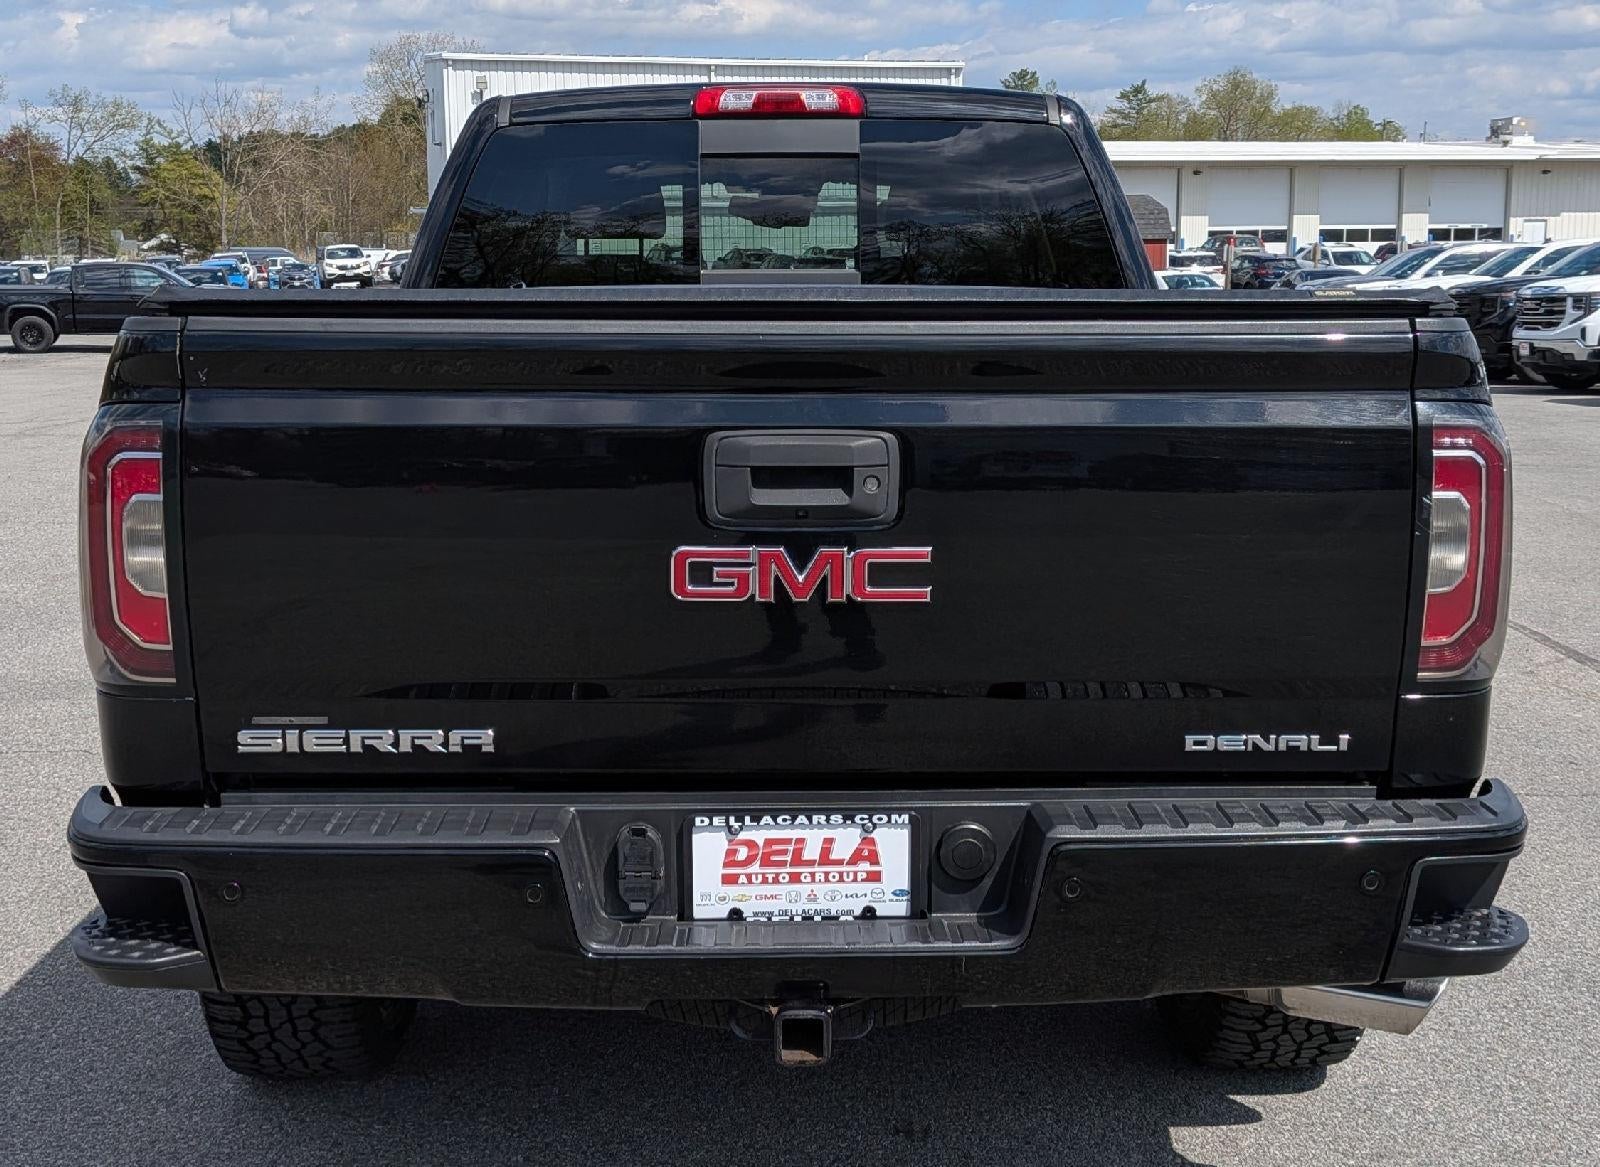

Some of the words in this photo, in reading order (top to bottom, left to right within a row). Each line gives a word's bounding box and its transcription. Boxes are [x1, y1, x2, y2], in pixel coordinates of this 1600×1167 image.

[671, 545, 933, 602] GMC
[237, 729, 495, 754] SIERRA
[1184, 734, 1351, 752] DENALI
[694, 814, 910, 827] DELLACARS.COM
[722, 836, 882, 869] DELLA
[737, 873, 790, 884] AUTO
[800, 871, 868, 883] GROUP
[754, 893, 783, 901] GMC
